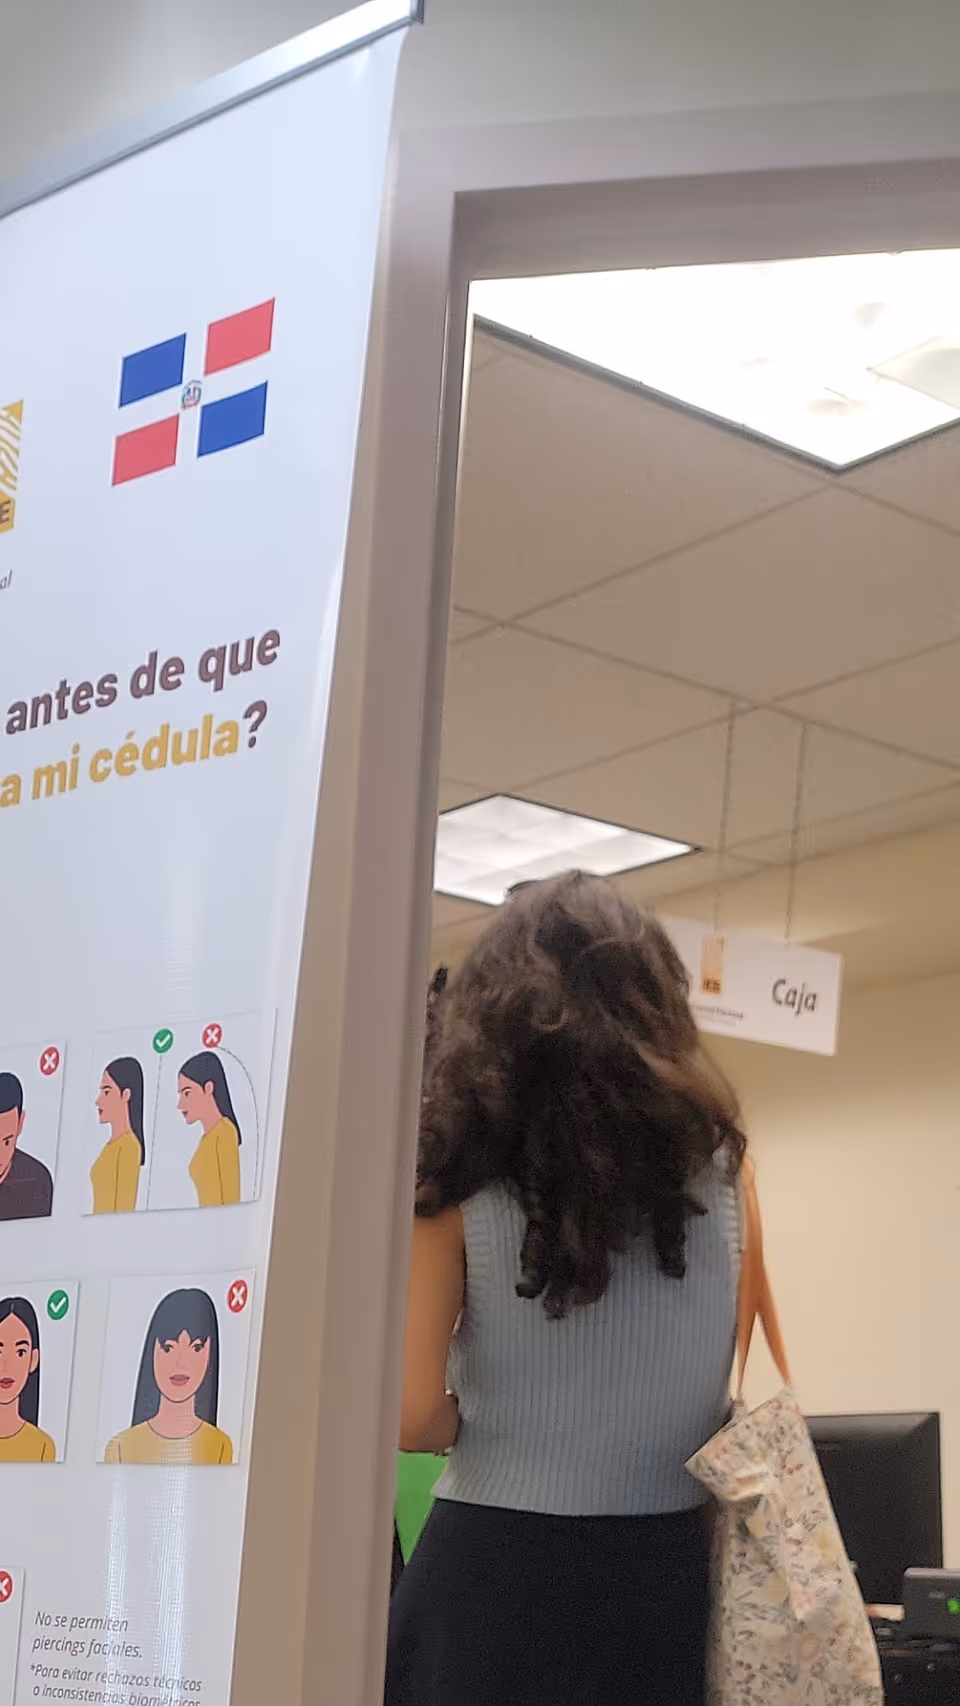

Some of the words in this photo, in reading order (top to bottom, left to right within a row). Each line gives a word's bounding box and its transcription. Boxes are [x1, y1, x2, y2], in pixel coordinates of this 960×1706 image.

[6, 672, 118, 735] antes
[130, 650, 185, 697] de
[198, 628, 281, 692] que
[32, 744, 80, 799] mi
[89, 701, 269, 782] cédula?
[772, 977, 818, 1016] Caja
[34, 1611, 52, 1627] No
[54, 1615, 68, 1628] se
[69, 1616, 129, 1633] permiten
[31, 1635, 86, 1657] piercings
[61, 1666, 93, 1682] evitar
[42, 1684, 125, 1705] inconsistencias
